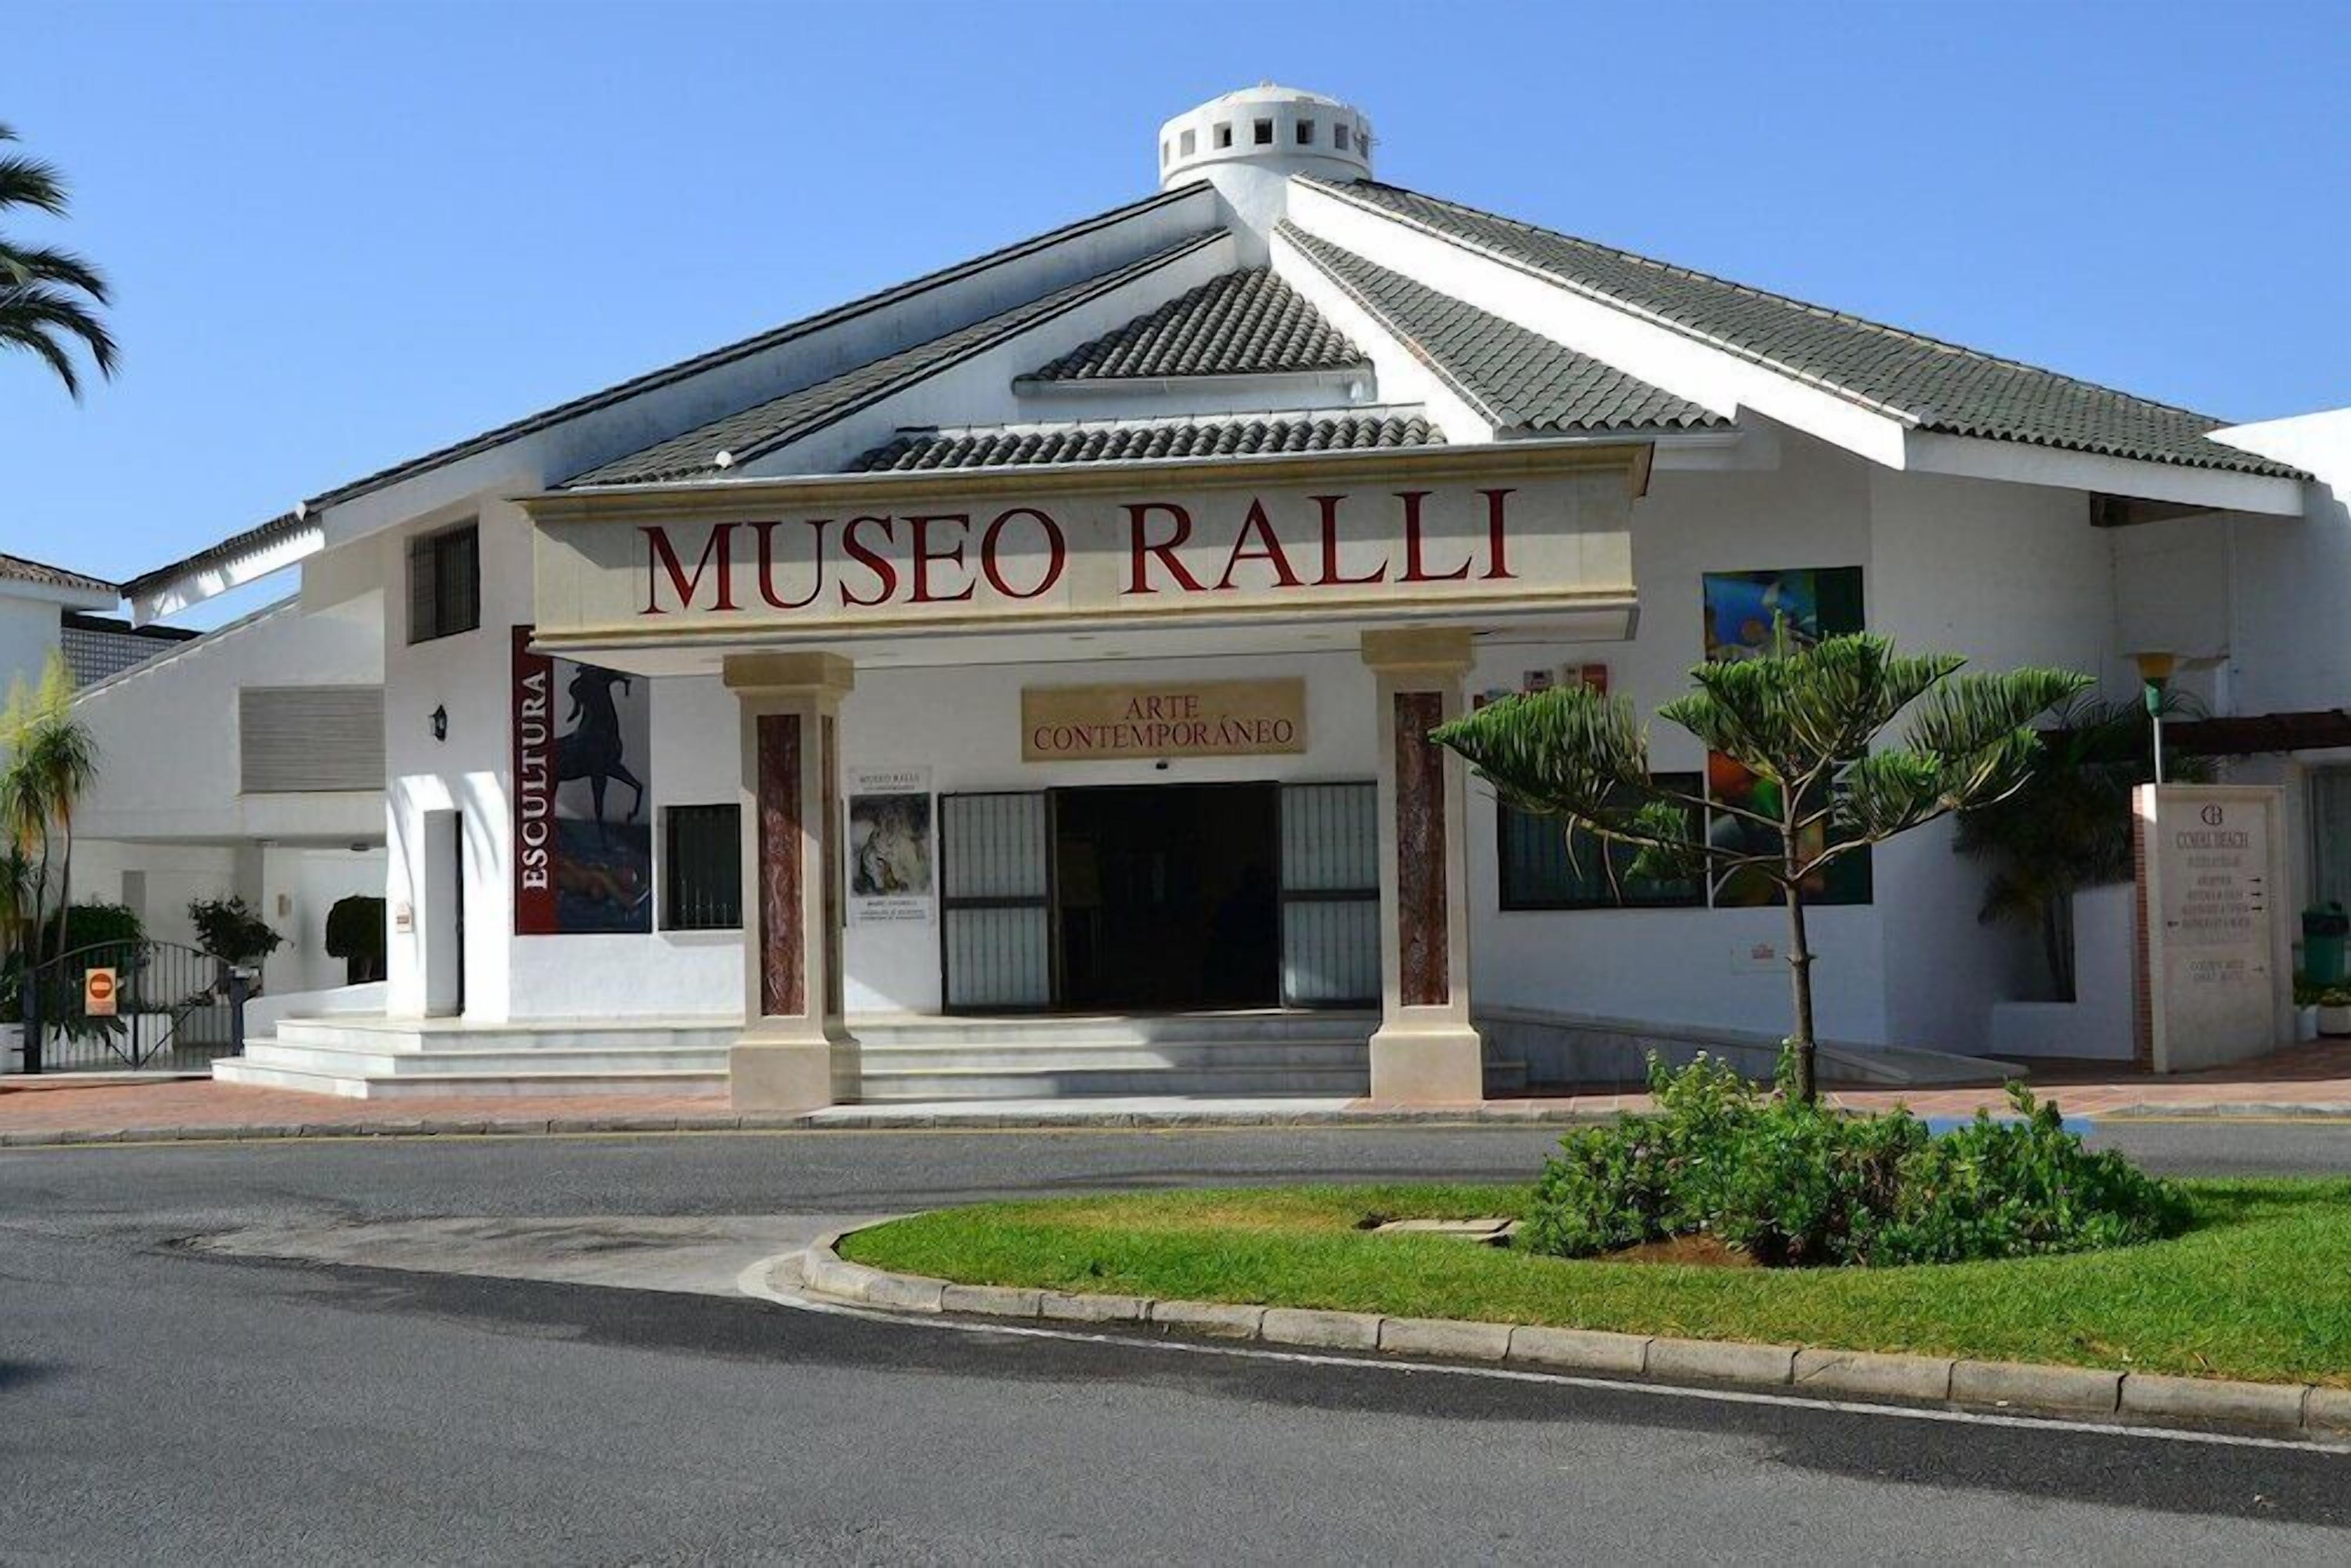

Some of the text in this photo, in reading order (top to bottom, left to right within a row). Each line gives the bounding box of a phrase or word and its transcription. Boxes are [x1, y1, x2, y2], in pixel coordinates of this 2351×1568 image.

[637, 488, 1519, 615] MUSEO RALLI
[1033, 714, 1293, 751] CONTEMPORÁNEO
[1126, 695, 1200, 720] ARTE
[521, 670, 548, 890] ESCULTURA
